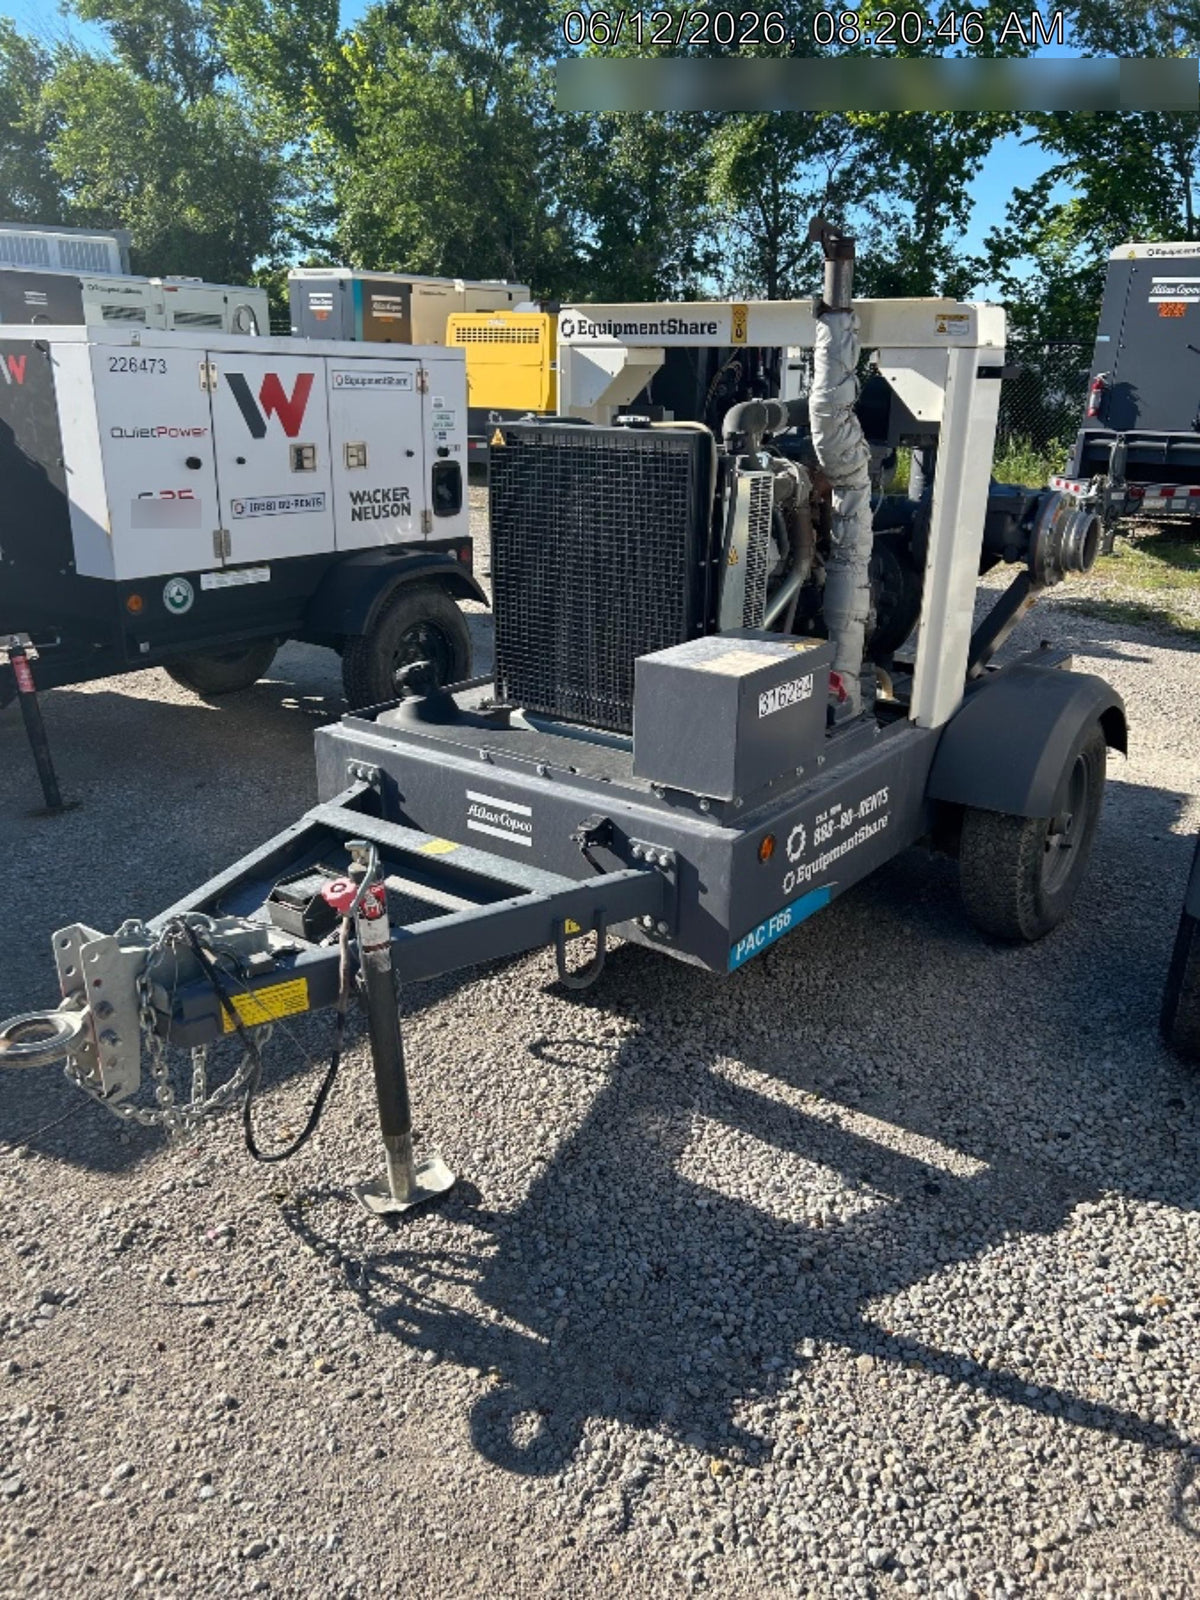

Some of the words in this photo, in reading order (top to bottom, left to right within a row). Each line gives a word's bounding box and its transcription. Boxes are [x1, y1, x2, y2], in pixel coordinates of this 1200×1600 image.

[578, 319, 718, 338] EquipmentShare
[109, 357, 168, 375] 226473
[110, 426, 209, 438] QuietPower
[350, 487, 411, 505] WACKER
[351, 503, 412, 522] NEUSON
[467, 804, 499, 824] Atlas
[500, 812, 532, 833] Copco
[796, 815, 889, 885] EquipmentShare
[735, 925, 766, 961] PAC
[769, 908, 792, 938] F66
